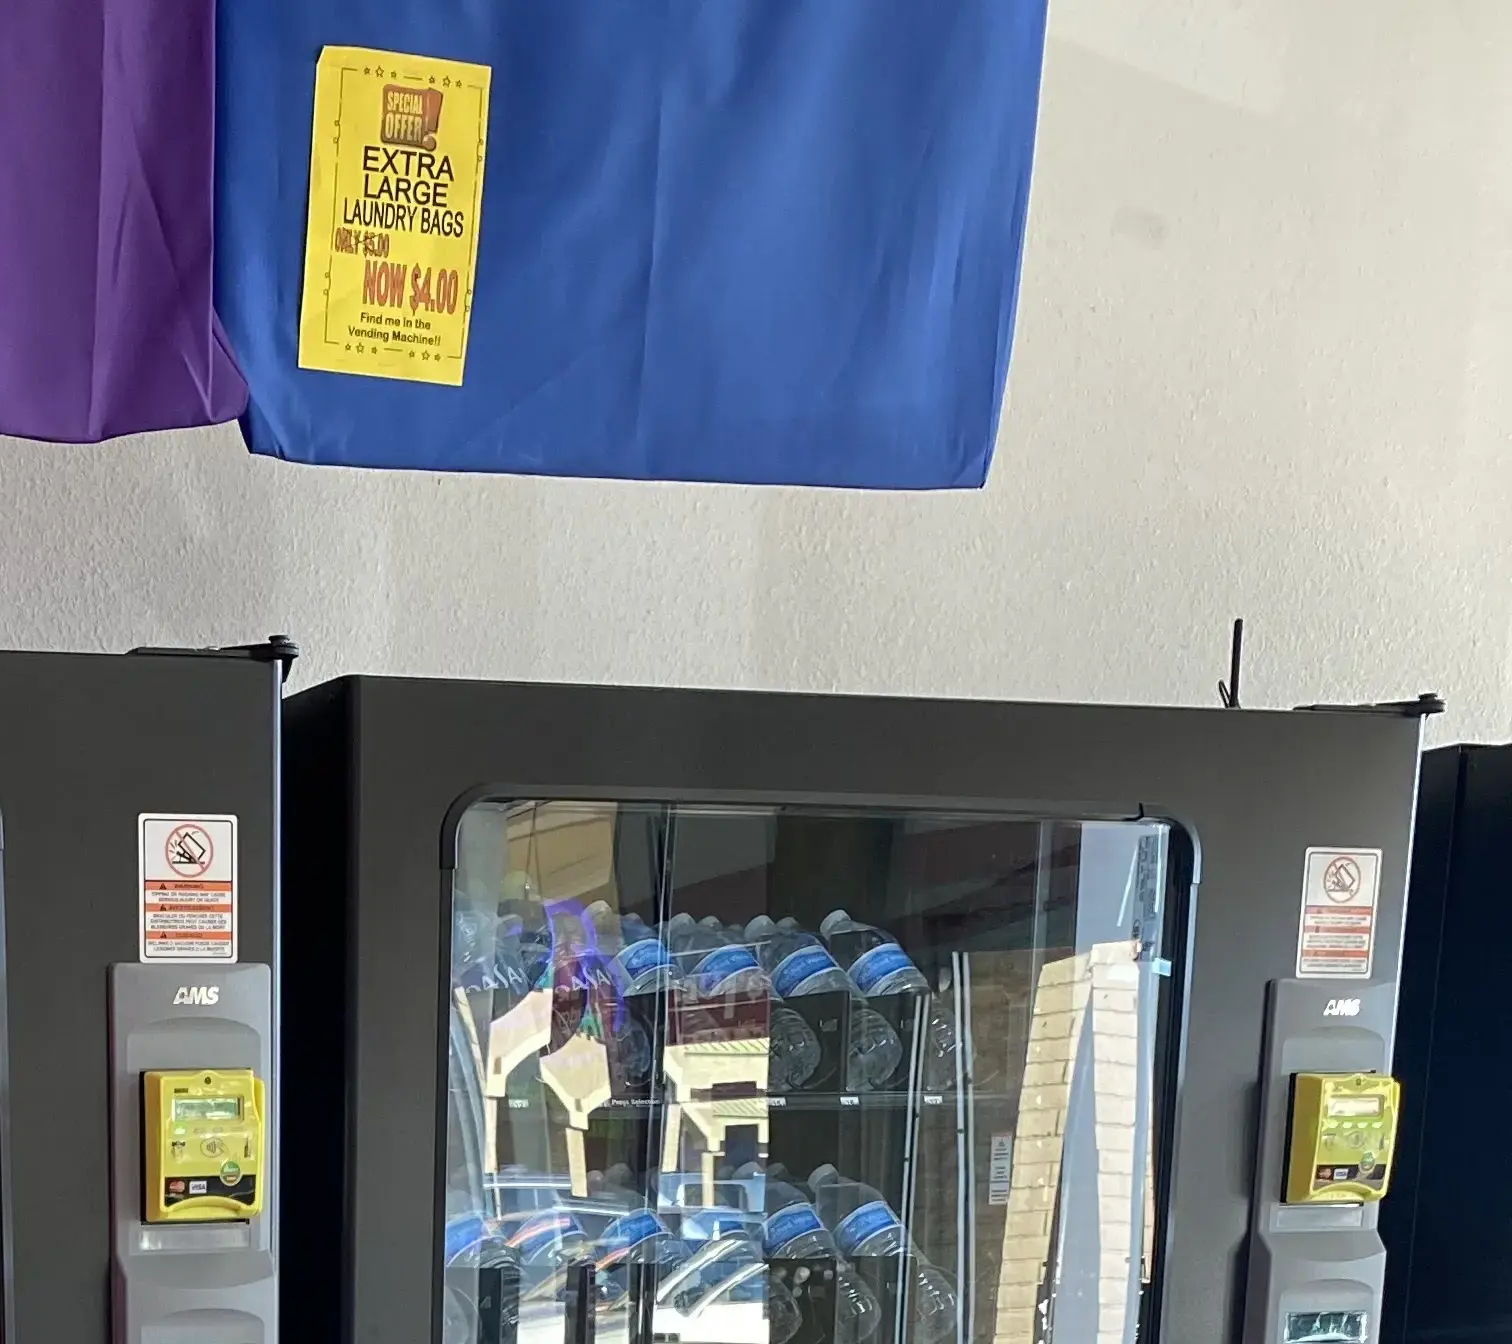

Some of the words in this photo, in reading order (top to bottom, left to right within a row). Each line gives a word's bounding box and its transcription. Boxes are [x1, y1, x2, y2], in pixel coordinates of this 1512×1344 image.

[387, 91, 423, 115] SPECIAL
[362, 145, 454, 182] EXTRA
[364, 173, 449, 208] LARGE
[343, 197, 418, 232] LAUNDRY
[421, 207, 465, 238] BAGS
[362, 260, 407, 308] NOW
[409, 263, 459, 316] $4.00
[360, 312, 382, 325] Find
[385, 316, 400, 327] me
[403, 316, 413, 328] in
[415, 318, 431, 330] the
[348, 325, 389, 342] Vending
[392, 330, 441, 346] Machine!!
[173, 985, 220, 1006] AMS
[1322, 998, 1362, 1017] AMS
